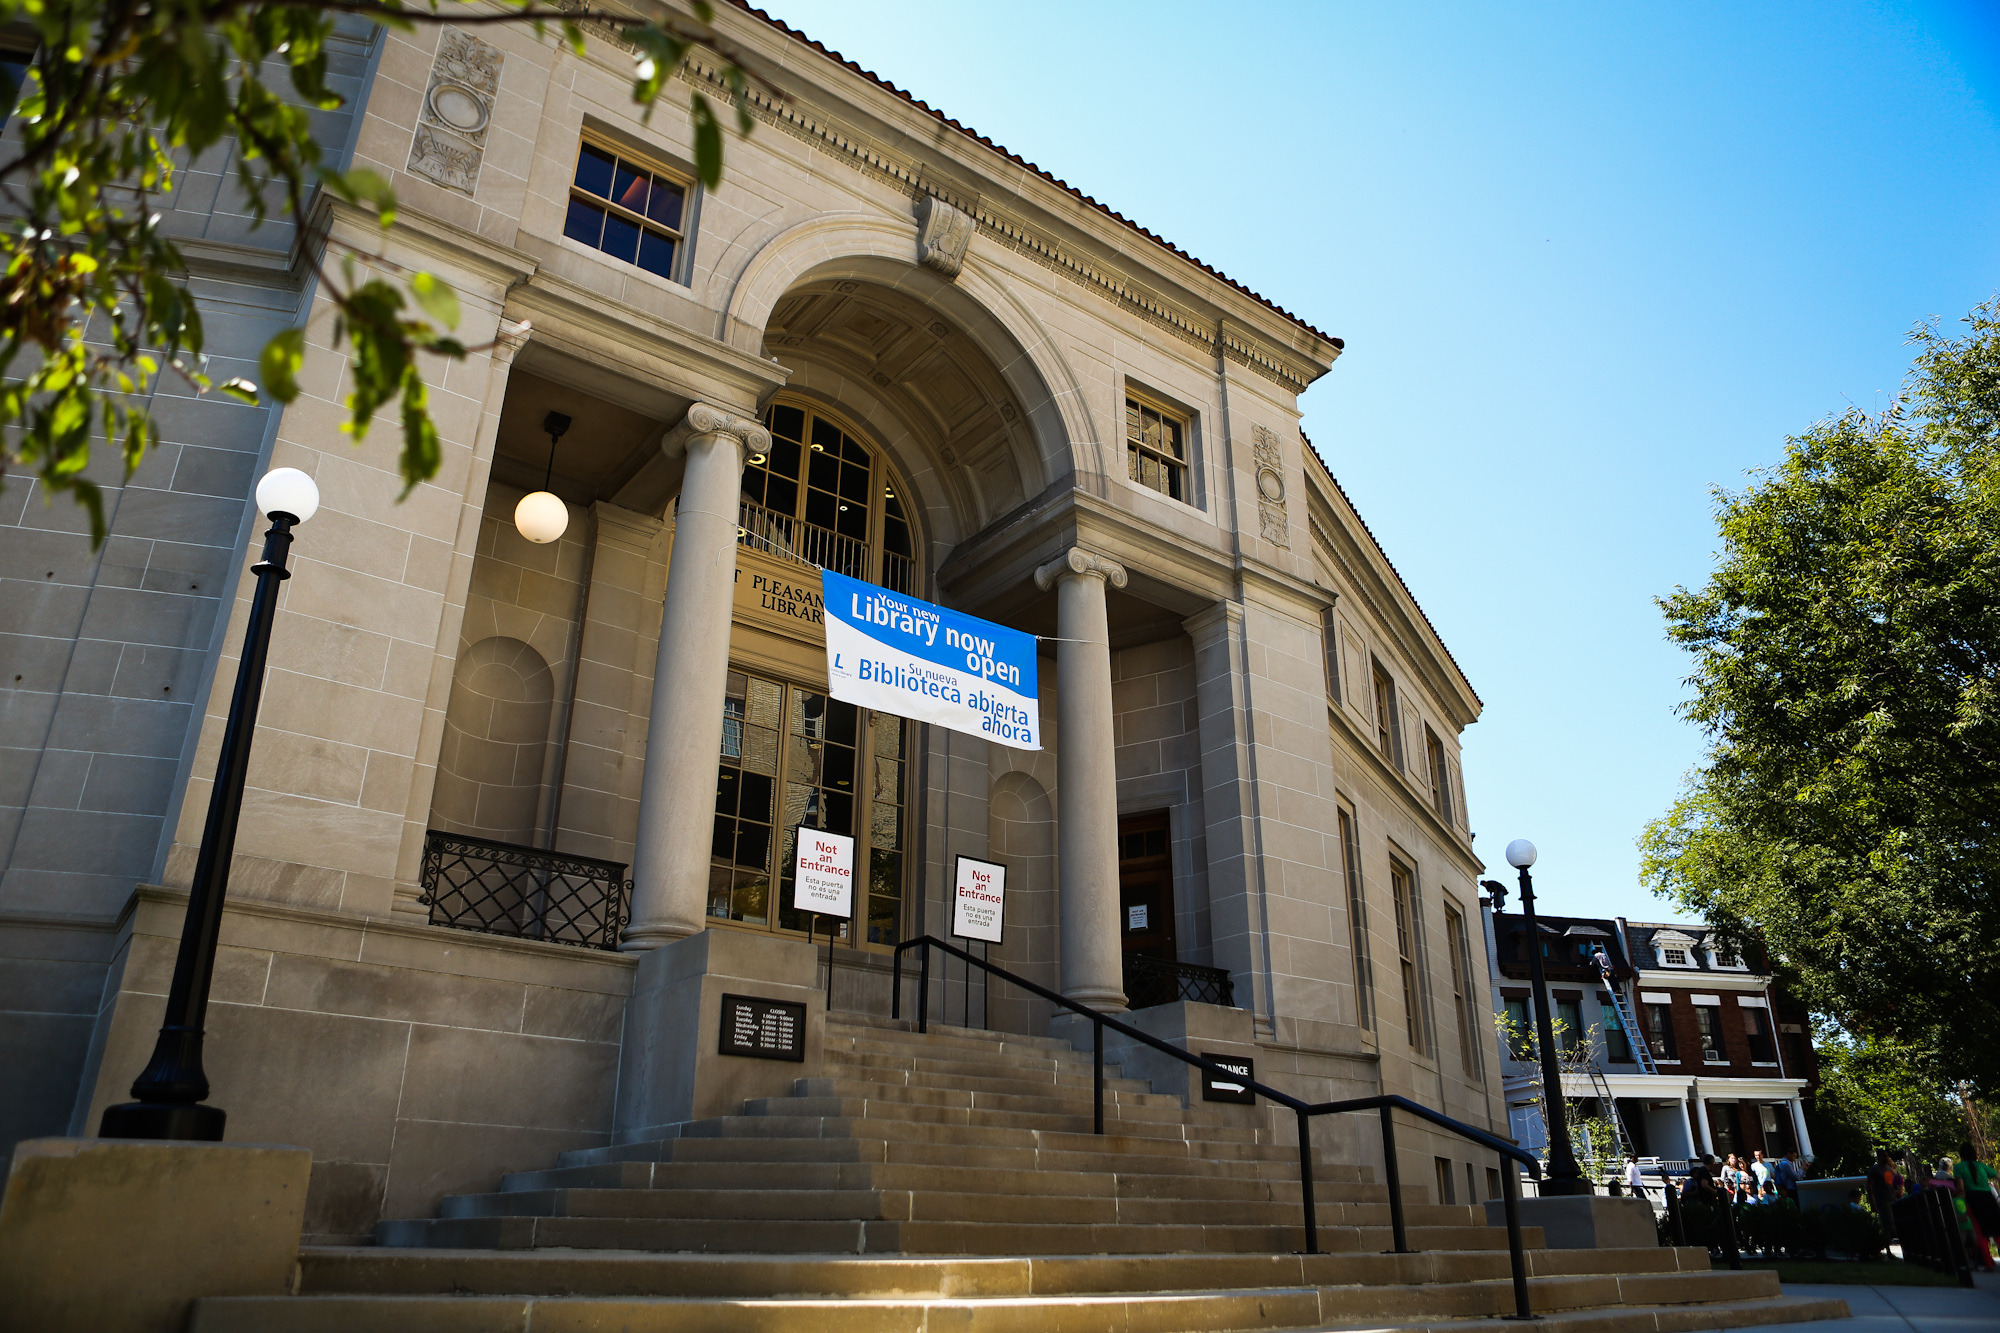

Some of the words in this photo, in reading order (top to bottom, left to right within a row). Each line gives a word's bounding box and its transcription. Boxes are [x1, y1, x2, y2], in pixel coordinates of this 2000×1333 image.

[752, 574, 824, 608] PLEASAN
[877, 593, 908, 613] Your
[912, 606, 940, 623] new
[852, 592, 939, 646] Library
[946, 627, 995, 659] now
[909, 663, 921, 677] Su
[925, 670, 957, 686] nueva
[966, 652, 1020, 686] open
[859, 658, 961, 704] Biblioteca
[968, 690, 1029, 726] abierta
[982, 715, 1032, 744] ahora
[816, 841, 838, 855] Not
[800, 857, 850, 877] Entrance
[820, 854, 832, 863] an
[806, 875, 820, 884] Esta
[822, 880, 843, 889] puerta
[972, 869, 991, 883] Not
[810, 891, 837, 901] entrada
[960, 886, 1002, 904] Entrance
[976, 882, 987, 892] an
[964, 903, 976, 912] Esta
[976, 907, 996, 916] puerta
[968, 918, 990, 927] entrada
